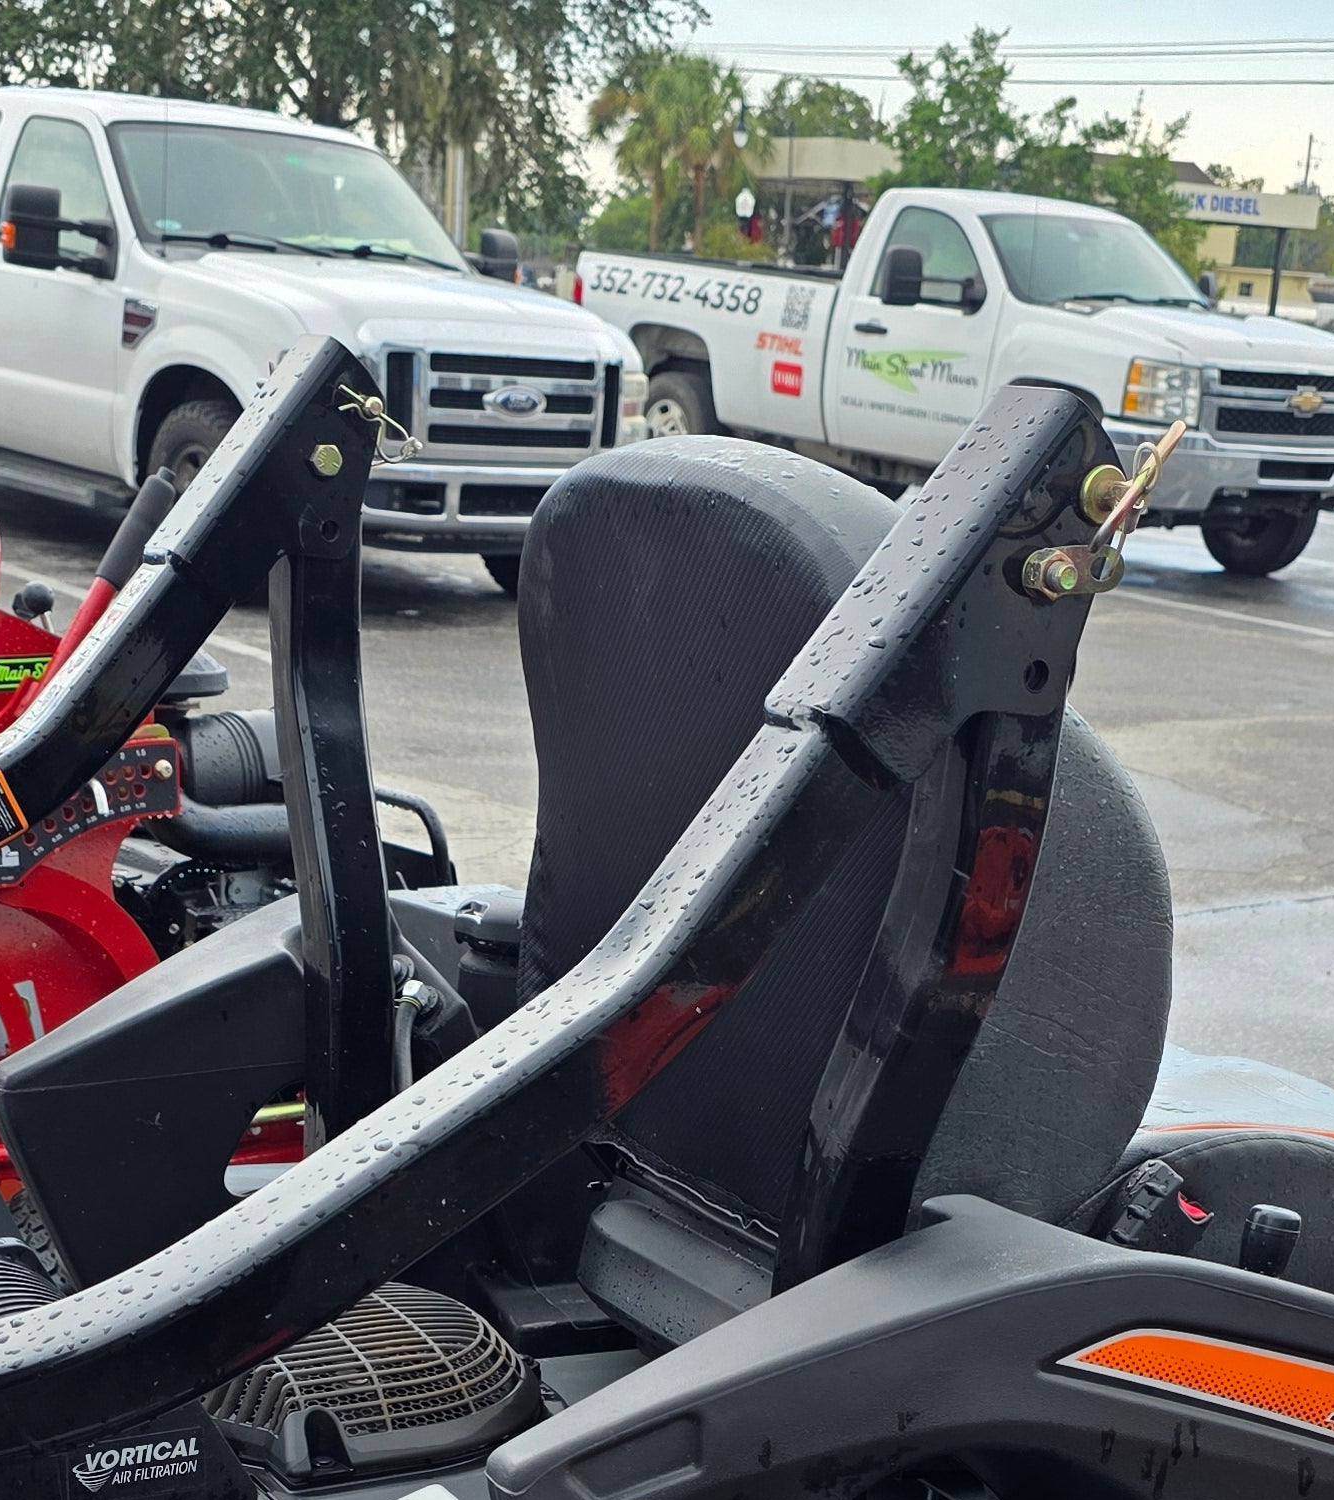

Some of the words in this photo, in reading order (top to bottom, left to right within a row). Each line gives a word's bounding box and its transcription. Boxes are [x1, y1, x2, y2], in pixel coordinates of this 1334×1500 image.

[1210, 195, 1260, 216] DIESEL
[590, 265, 763, 315] 352-732-4358
[755, 332, 803, 356] STIHL
[846, 346, 882, 371] Main
[85, 1437, 200, 1472] VORTICAL
[111, 1470, 132, 1486] AIR
[134, 1460, 198, 1482] FILTRATION
